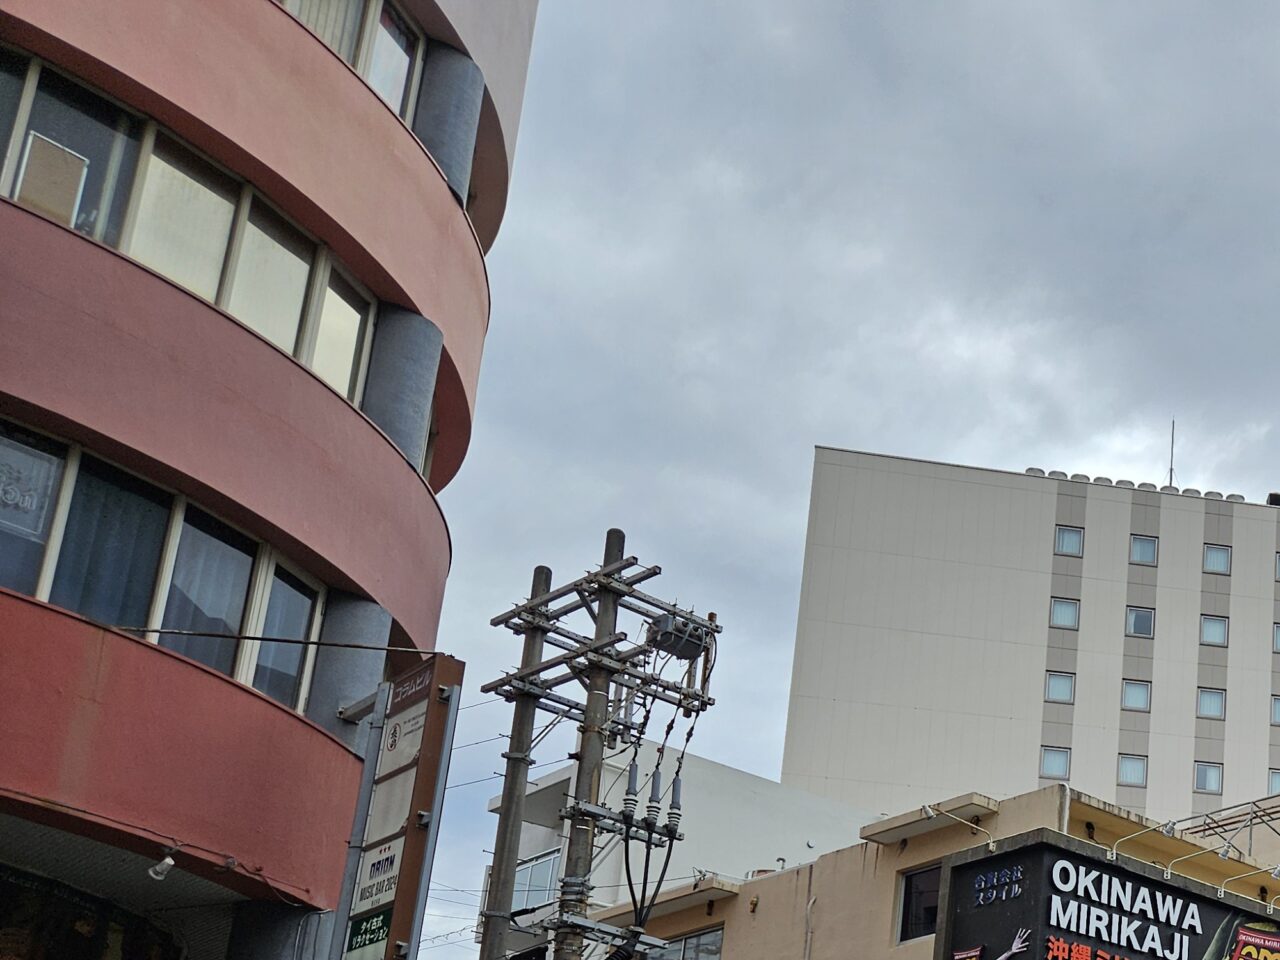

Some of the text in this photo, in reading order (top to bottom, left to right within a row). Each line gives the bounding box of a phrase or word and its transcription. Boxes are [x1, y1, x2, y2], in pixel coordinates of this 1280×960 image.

[394, 671, 432, 702] コラムビル
[369, 854, 396, 880] ORION
[1051, 858, 1204, 935] OKINAWA
[361, 914, 385, 935] タイ古式
